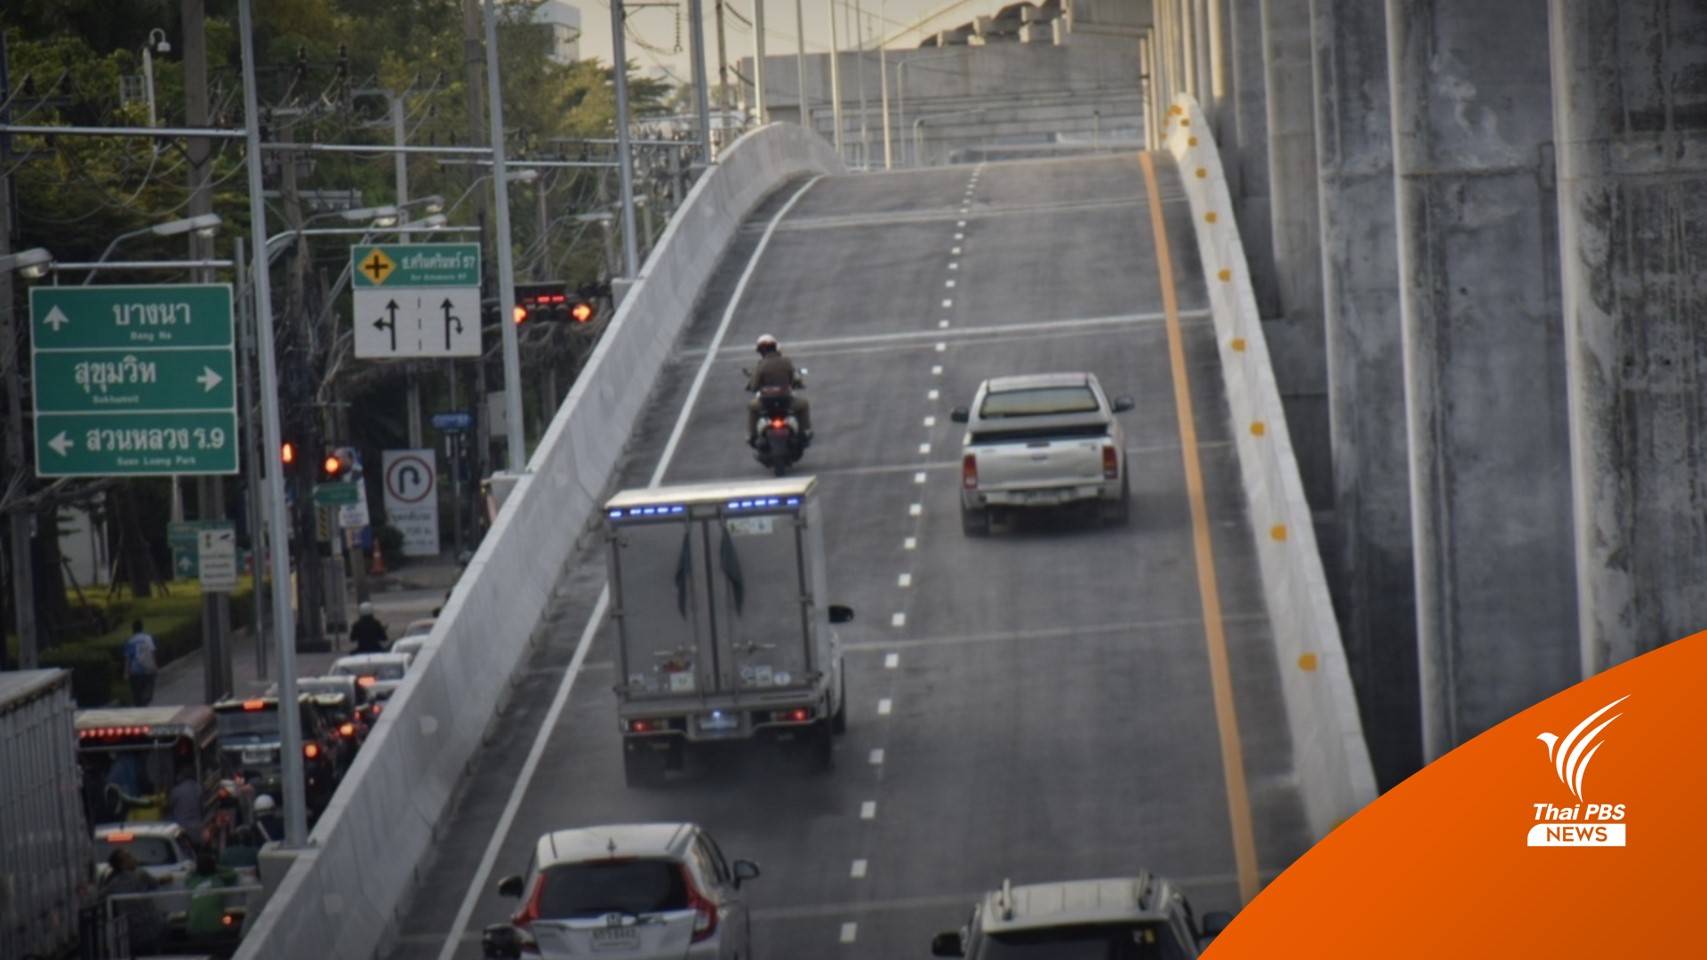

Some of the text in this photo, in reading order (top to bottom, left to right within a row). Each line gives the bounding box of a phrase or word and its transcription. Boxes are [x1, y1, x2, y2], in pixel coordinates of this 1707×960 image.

[112, 302, 191, 326] บางนา
[130, 331, 172, 342] Bang Na
[74, 354, 157, 394] สุขุมวิท
[86, 427, 225, 451] สวนหลวง ร.9
[176, 455, 196, 465] Park
